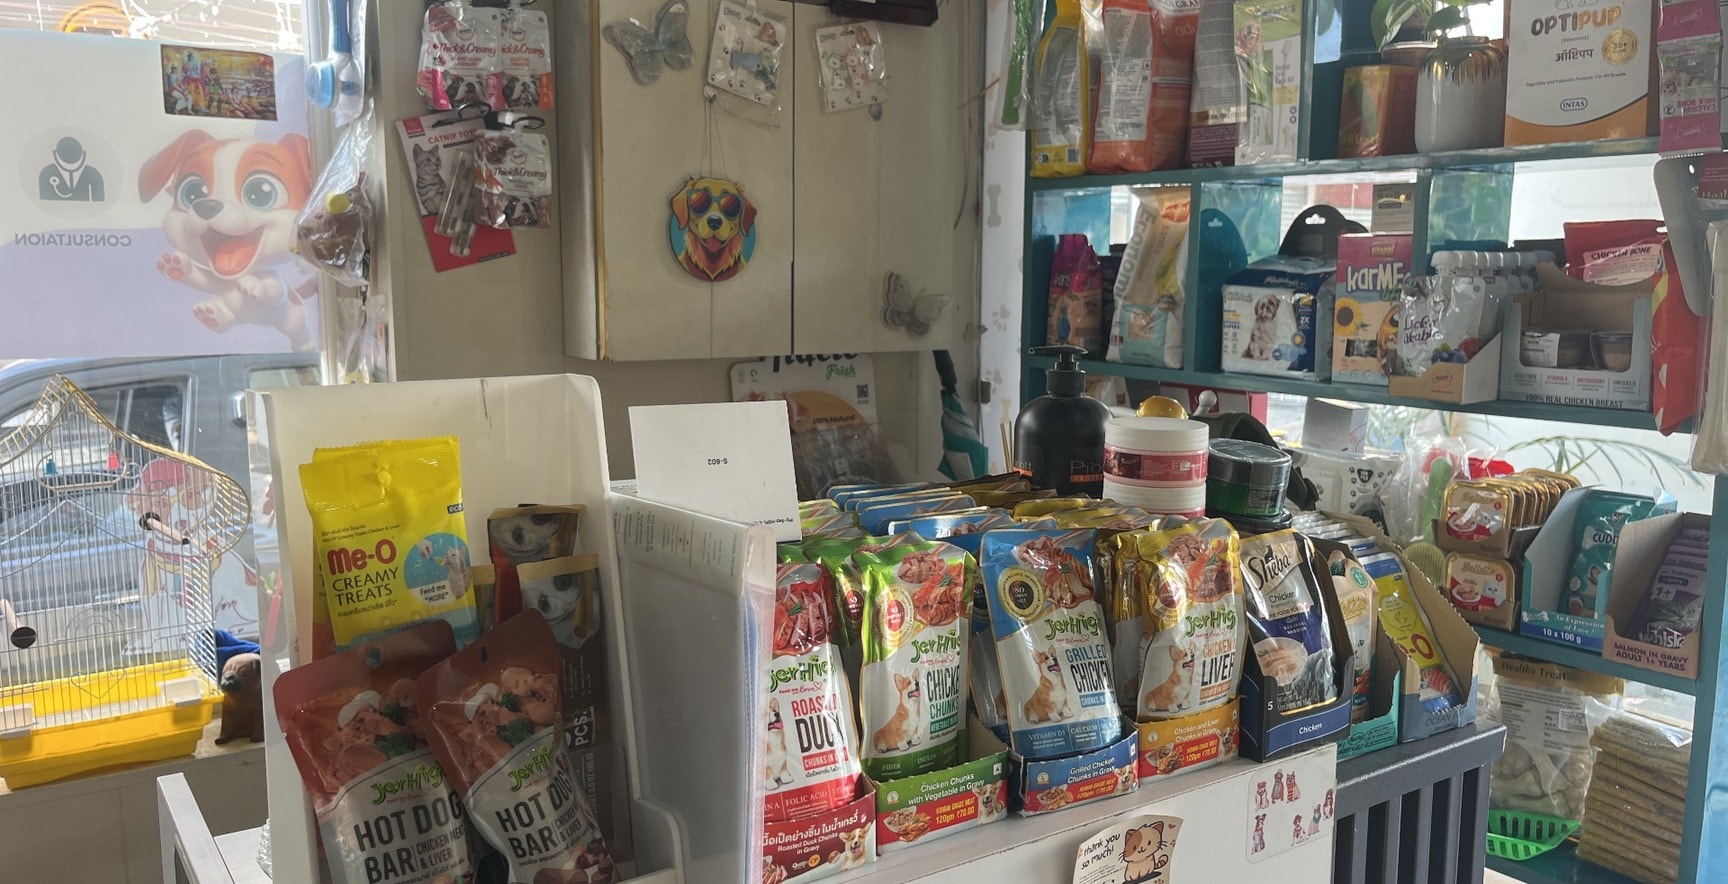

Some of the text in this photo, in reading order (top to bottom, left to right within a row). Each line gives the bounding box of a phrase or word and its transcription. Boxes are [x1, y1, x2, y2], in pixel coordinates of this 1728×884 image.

[1530, 5, 1622, 36] OPTIPUP
[502, 43, 546, 59] ick&Creamy
[1346, 261, 1411, 293] karME
[1545, 395, 1563, 403] REAL
[1564, 397, 1594, 407] CHICKEN
[1595, 398, 1623, 408] BREAST
[326, 539, 398, 576] Me-O
[332, 566, 399, 592] CREAMY
[1247, 554, 1290, 591] Sheba
[334, 582, 393, 607] TREATS
[420, 584, 446, 596] Feed me
[1543, 627, 1552, 637] 10
[1561, 631, 1574, 642] 100
[1613, 643, 1688, 664] SALMON IN GRAVY
[1615, 649, 1686, 672] ADULT 1+ YEARS
[1501, 661, 1566, 680] Healthy Treat
[1267, 700, 1274, 711] 5
[1028, 731, 1057, 742] VITAMIN
[1057, 728, 1066, 738] D3
[1070, 724, 1098, 735] CALCIUM
[1298, 722, 1323, 735] Chicken
[1070, 757, 1115, 775] Grilled Chicken
[920, 773, 975, 793] Chicken Chunks
[1067, 773, 1091, 784] Chunks
[786, 790, 828, 807] FOLIC ACID
[908, 796, 923, 805] with
[924, 787, 958, 802] Vegetable
[966, 779, 986, 790] Gravy
[353, 789, 463, 852] HOT DOG
[495, 792, 546, 833] HOT
[936, 805, 975, 825] 120gm ₹70.00
[416, 833, 450, 856] CHICKEN
[507, 825, 559, 860] BAR
[777, 832, 838, 853] Roasted Duck Chunks
[803, 844, 820, 855] Gravy
[1083, 832, 1121, 857] thank you
[363, 846, 417, 884] BAR
[420, 847, 454, 869] & LIVER
[1081, 845, 1115, 871] so much!
